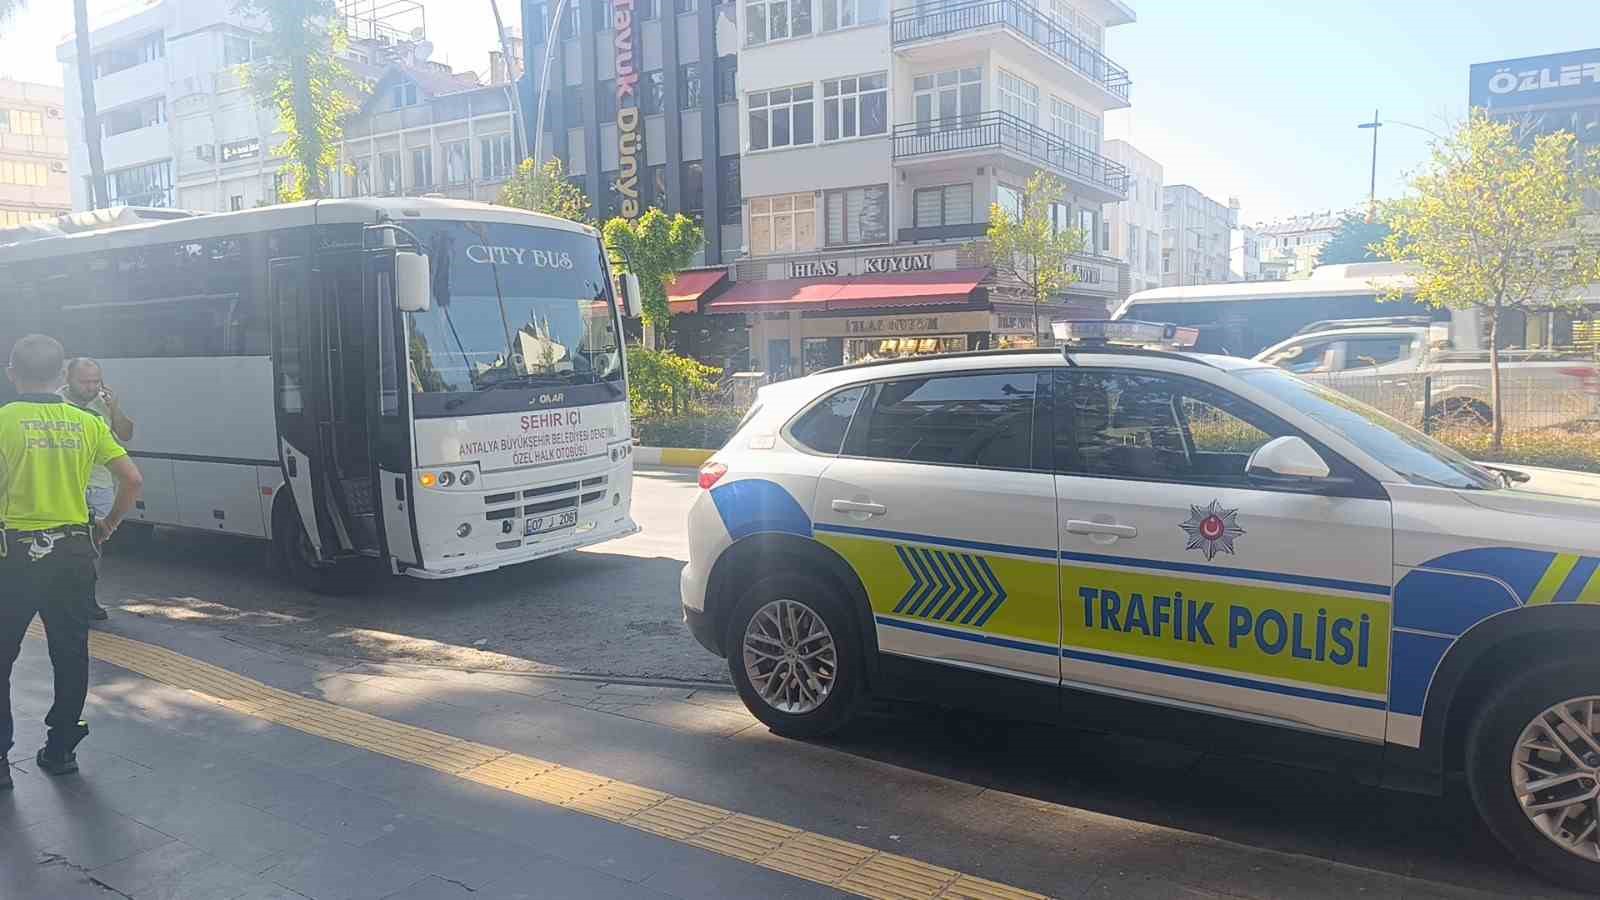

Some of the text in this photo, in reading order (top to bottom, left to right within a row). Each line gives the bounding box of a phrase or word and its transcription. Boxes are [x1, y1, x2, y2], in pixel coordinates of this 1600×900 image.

[613, 0, 642, 229] Tavuk Dünya
[465, 244, 574, 270] CITY BUS
[863, 254, 931, 273] KUYUM
[520, 410, 563, 432] ŞEHİR
[459, 439, 500, 456] ANTALYA
[534, 446, 556, 462] HALK
[532, 518, 544, 531] 07
[1078, 591, 1372, 669] TRAFİK POLİSİ
